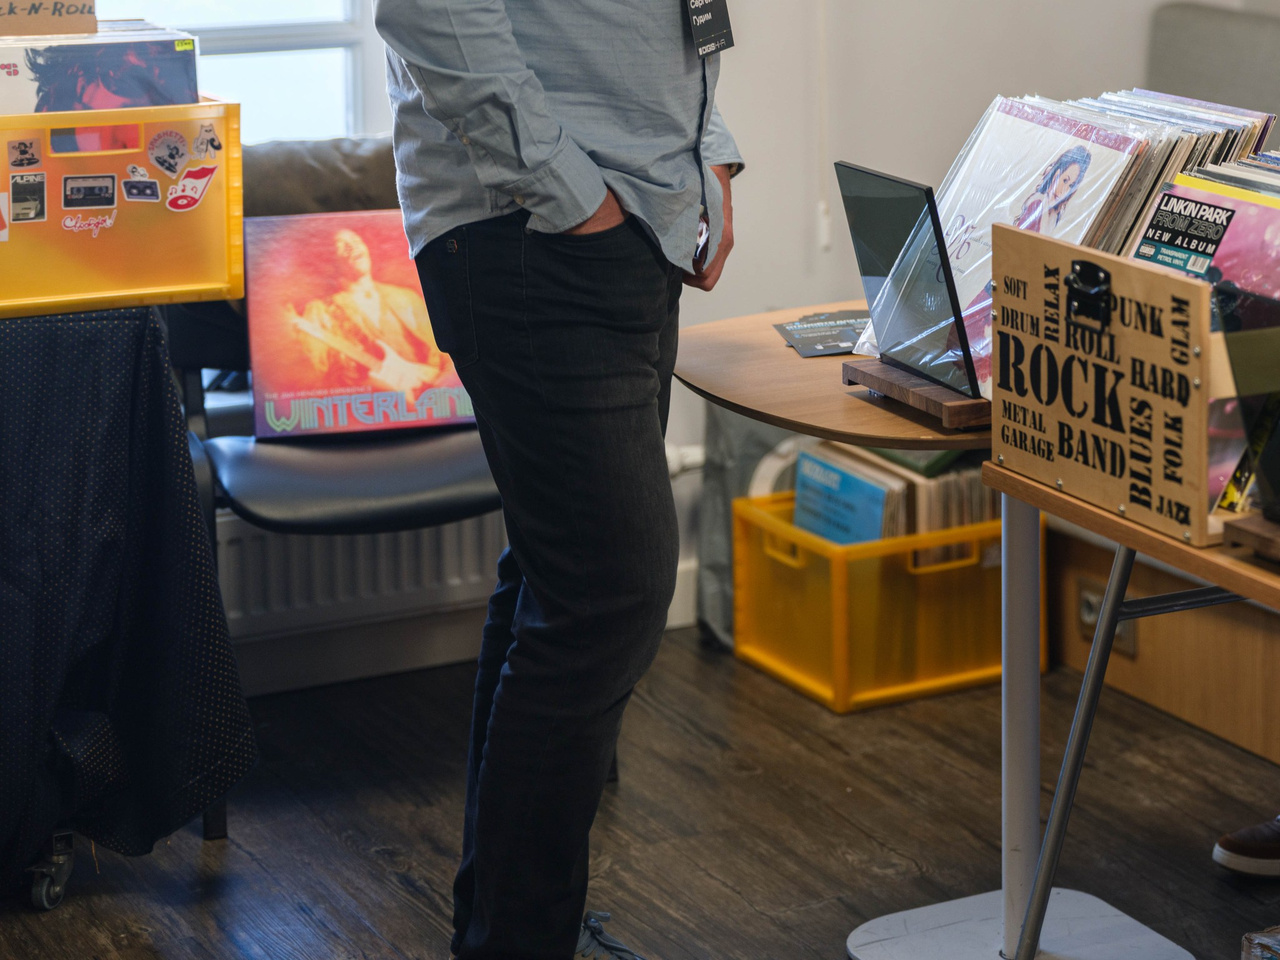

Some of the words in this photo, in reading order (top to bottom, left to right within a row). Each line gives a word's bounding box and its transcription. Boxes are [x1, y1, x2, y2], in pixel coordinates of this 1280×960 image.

[1152, 210, 1191, 232] FROM
[1187, 218, 1224, 240] ZERO
[1160, 196, 1201, 218] LINKIN
[1196, 204, 1232, 226] PARK
[1146, 228, 1172, 242] NEW
[1174, 235, 1217, 255] ALBUM
[1003, 275, 1028, 301] SOFT
[1044, 264, 1060, 344] RELAX
[1001, 305, 1040, 338] DRUM
[1170, 294, 1190, 366] GLAM
[1064, 322, 1121, 365] ROLL
[997, 329, 1126, 435] ROCK
[1130, 356, 1190, 408] HARD
[1002, 399, 1046, 434] METAL
[1001, 424, 1055, 462] GARAGE
[1057, 420, 1126, 480] BAND
[1129, 396, 1153, 511] BLUES
[1163, 411, 1183, 486] FOLK
